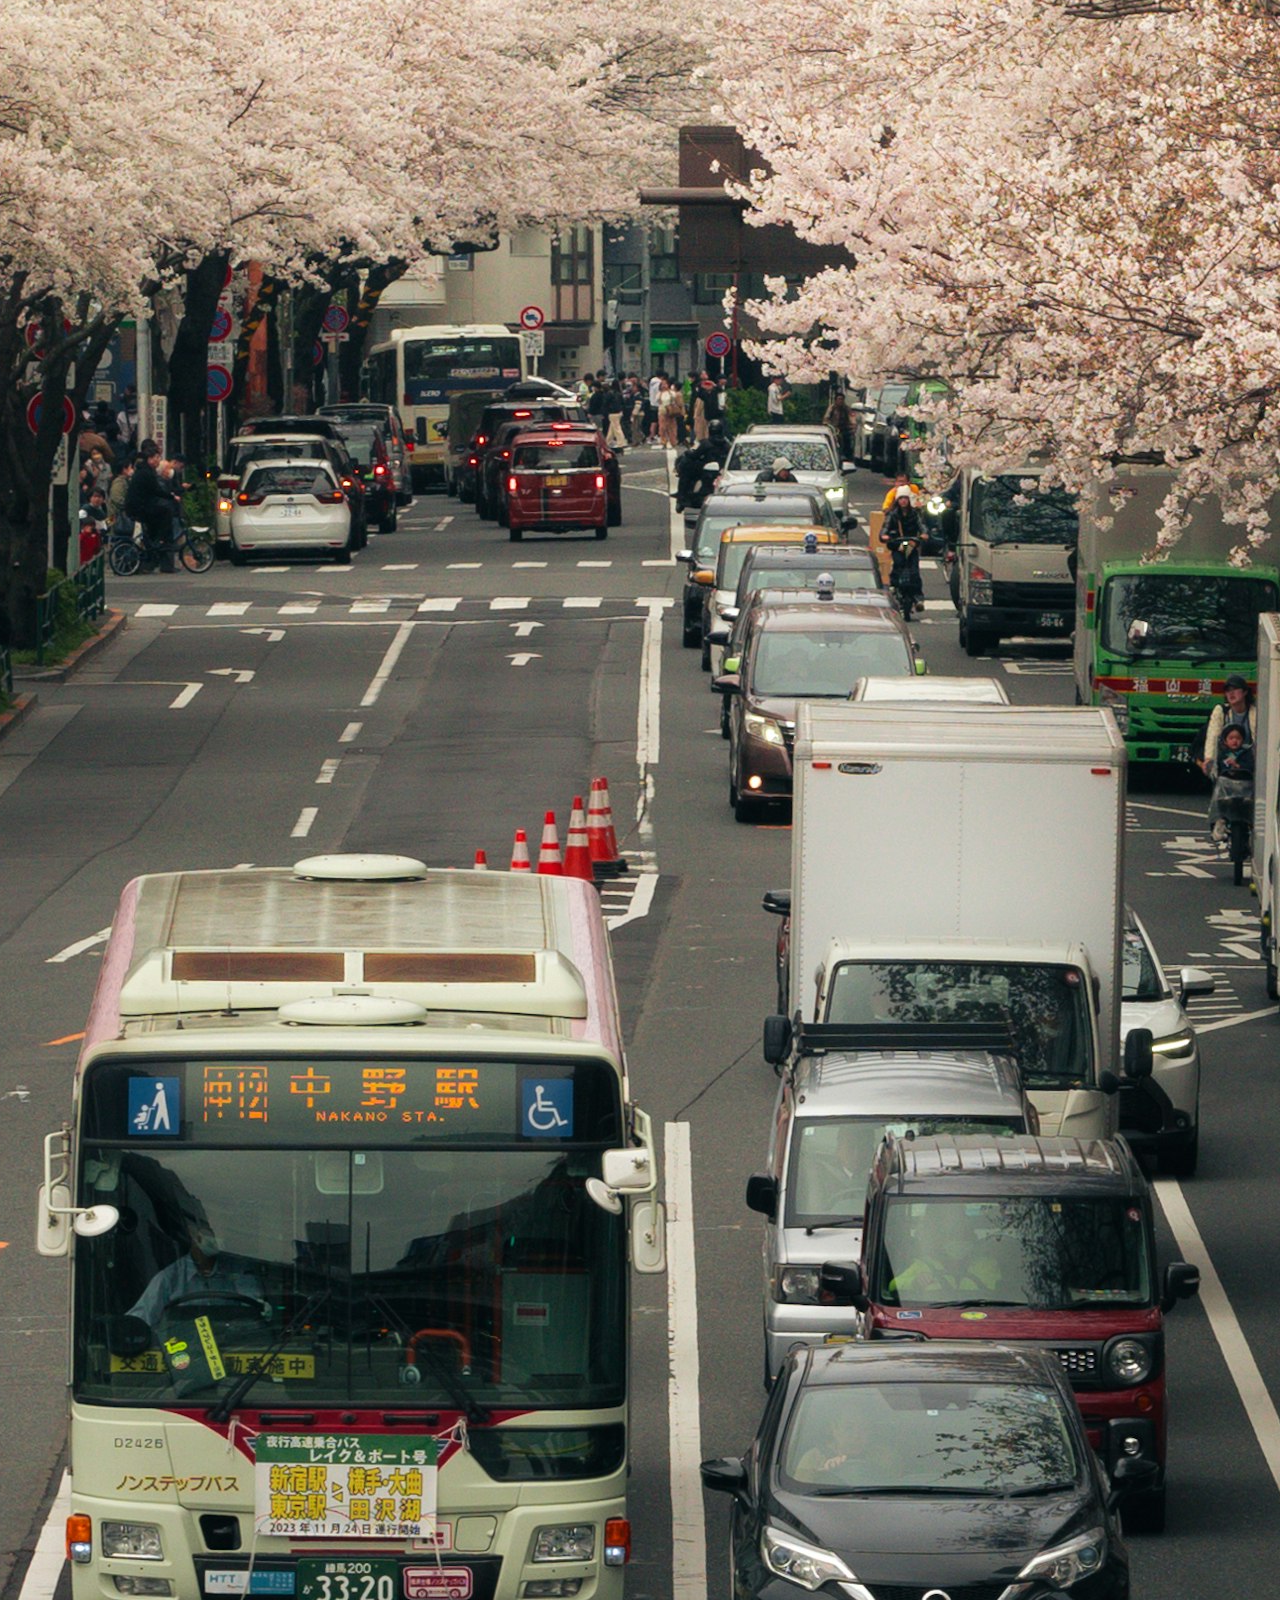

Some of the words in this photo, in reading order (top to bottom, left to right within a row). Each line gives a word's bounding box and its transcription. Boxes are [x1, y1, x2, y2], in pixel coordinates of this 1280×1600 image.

[290, 1067, 480, 1109] 中野駅
[316, 1111, 388, 1122] NAKANO
[402, 1111, 446, 1122] STA.
[114, 1437, 164, 1449] D2426
[265, 1435, 361, 1449] 夜行高速乗合バス
[115, 1475, 240, 1492] ノンステップバス
[269, 1464, 328, 1493] 新宿駅
[269, 1492, 328, 1521] 東京駅
[348, 1498, 423, 1522] 田沢湖
[324, 1562, 372, 1574] 練馬200
